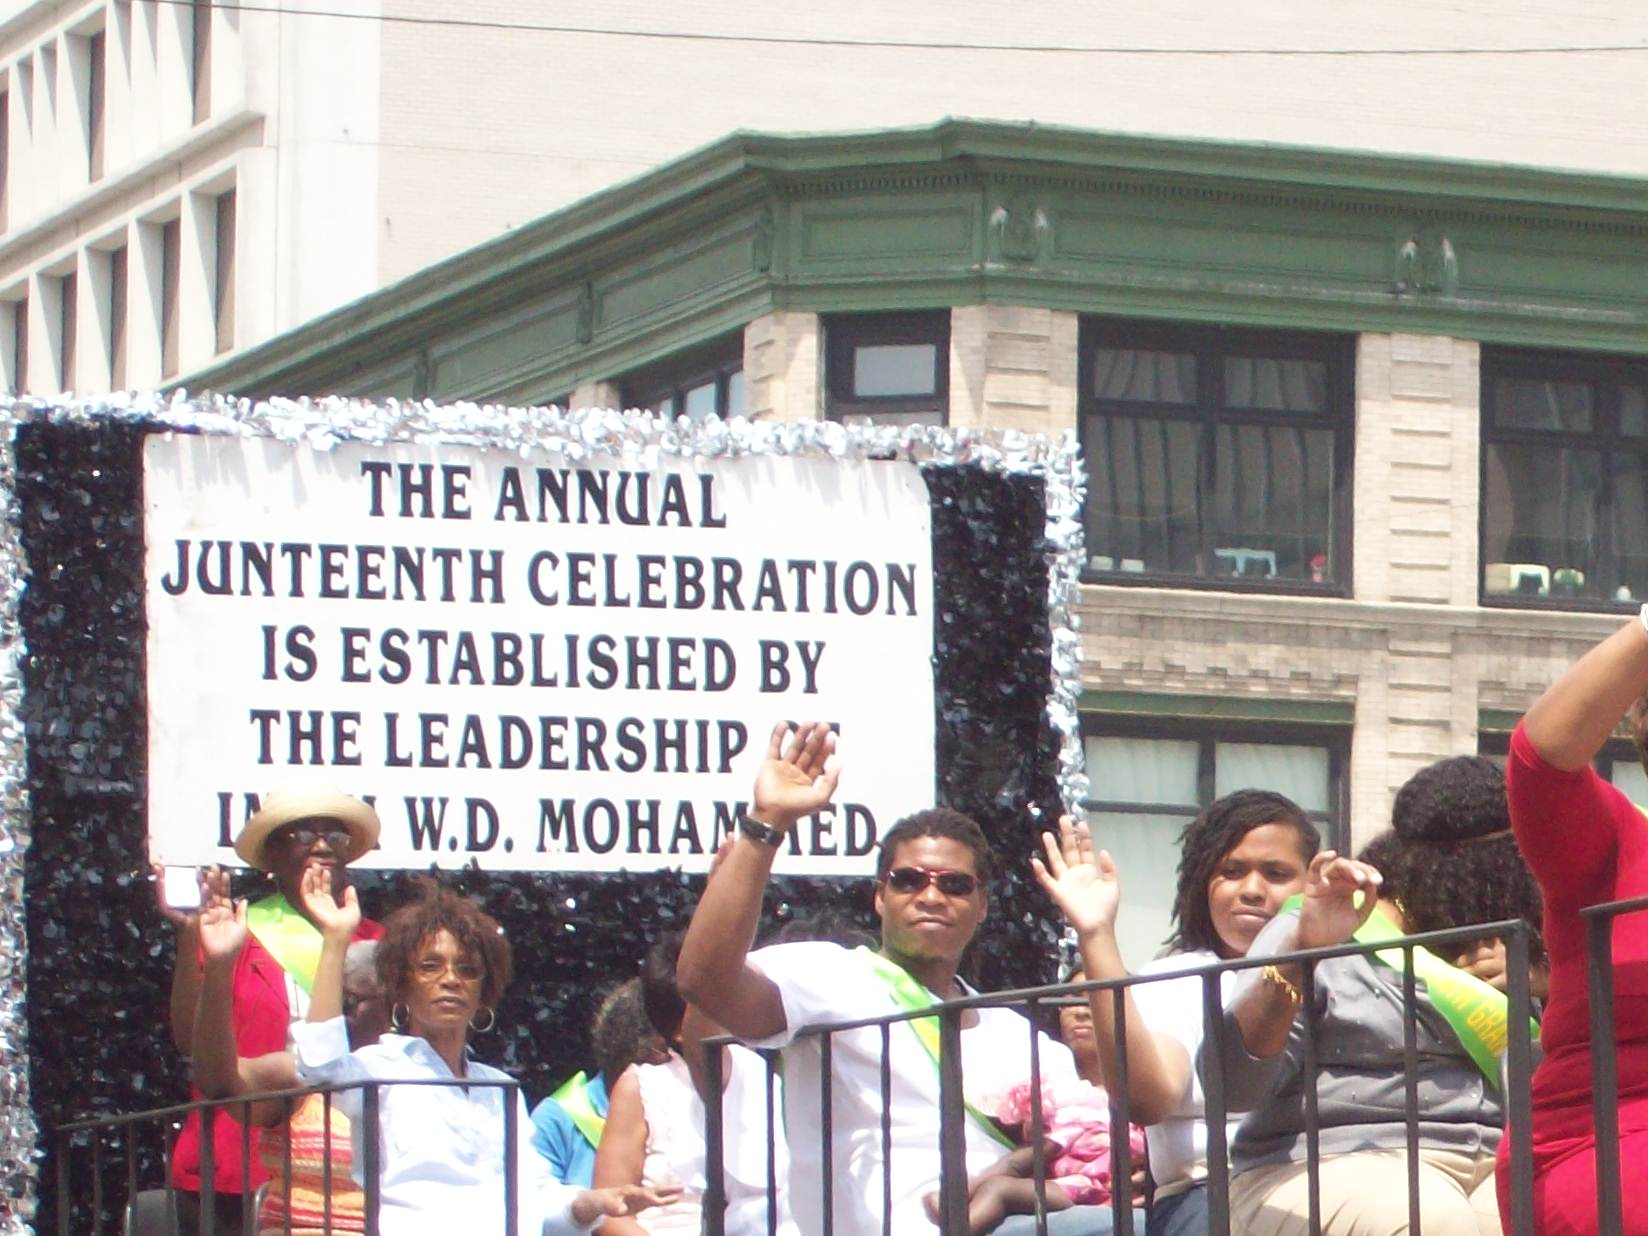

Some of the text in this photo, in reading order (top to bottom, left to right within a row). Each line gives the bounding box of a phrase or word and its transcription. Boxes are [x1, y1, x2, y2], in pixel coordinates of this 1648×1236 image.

[361, 461, 727, 529] THE ANNUAL
[160, 540, 918, 617] JUNTEENTH CELEBRATION
[262, 625, 825, 695] IS ESTABLISHED BY
[249, 709, 362, 766] THE
[384, 713, 749, 774] LEADERSHIP
[404, 797, 514, 853] W.D.
[536, 798, 878, 857] MOHAMED
